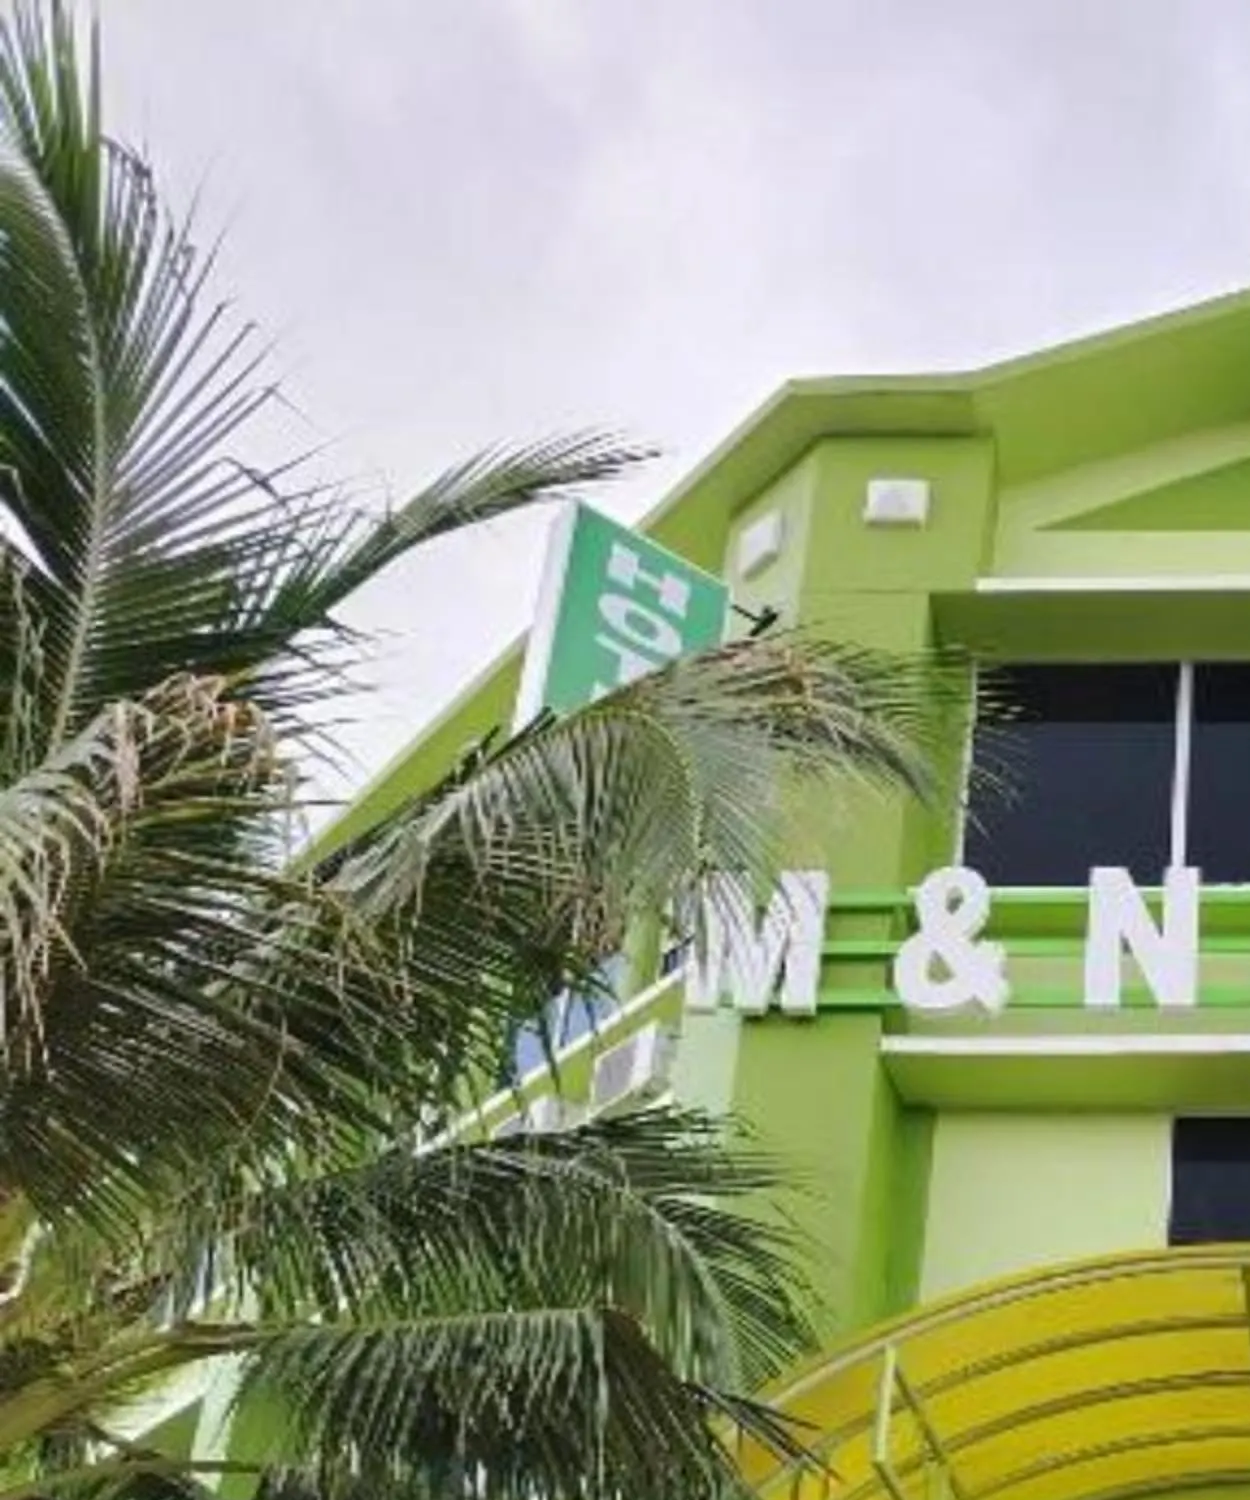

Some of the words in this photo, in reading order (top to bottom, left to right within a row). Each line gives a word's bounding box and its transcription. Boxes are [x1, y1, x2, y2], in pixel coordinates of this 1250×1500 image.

[684, 869, 829, 1015] M
[895, 866, 1010, 1017] &
[1085, 866, 1201, 1010] N
